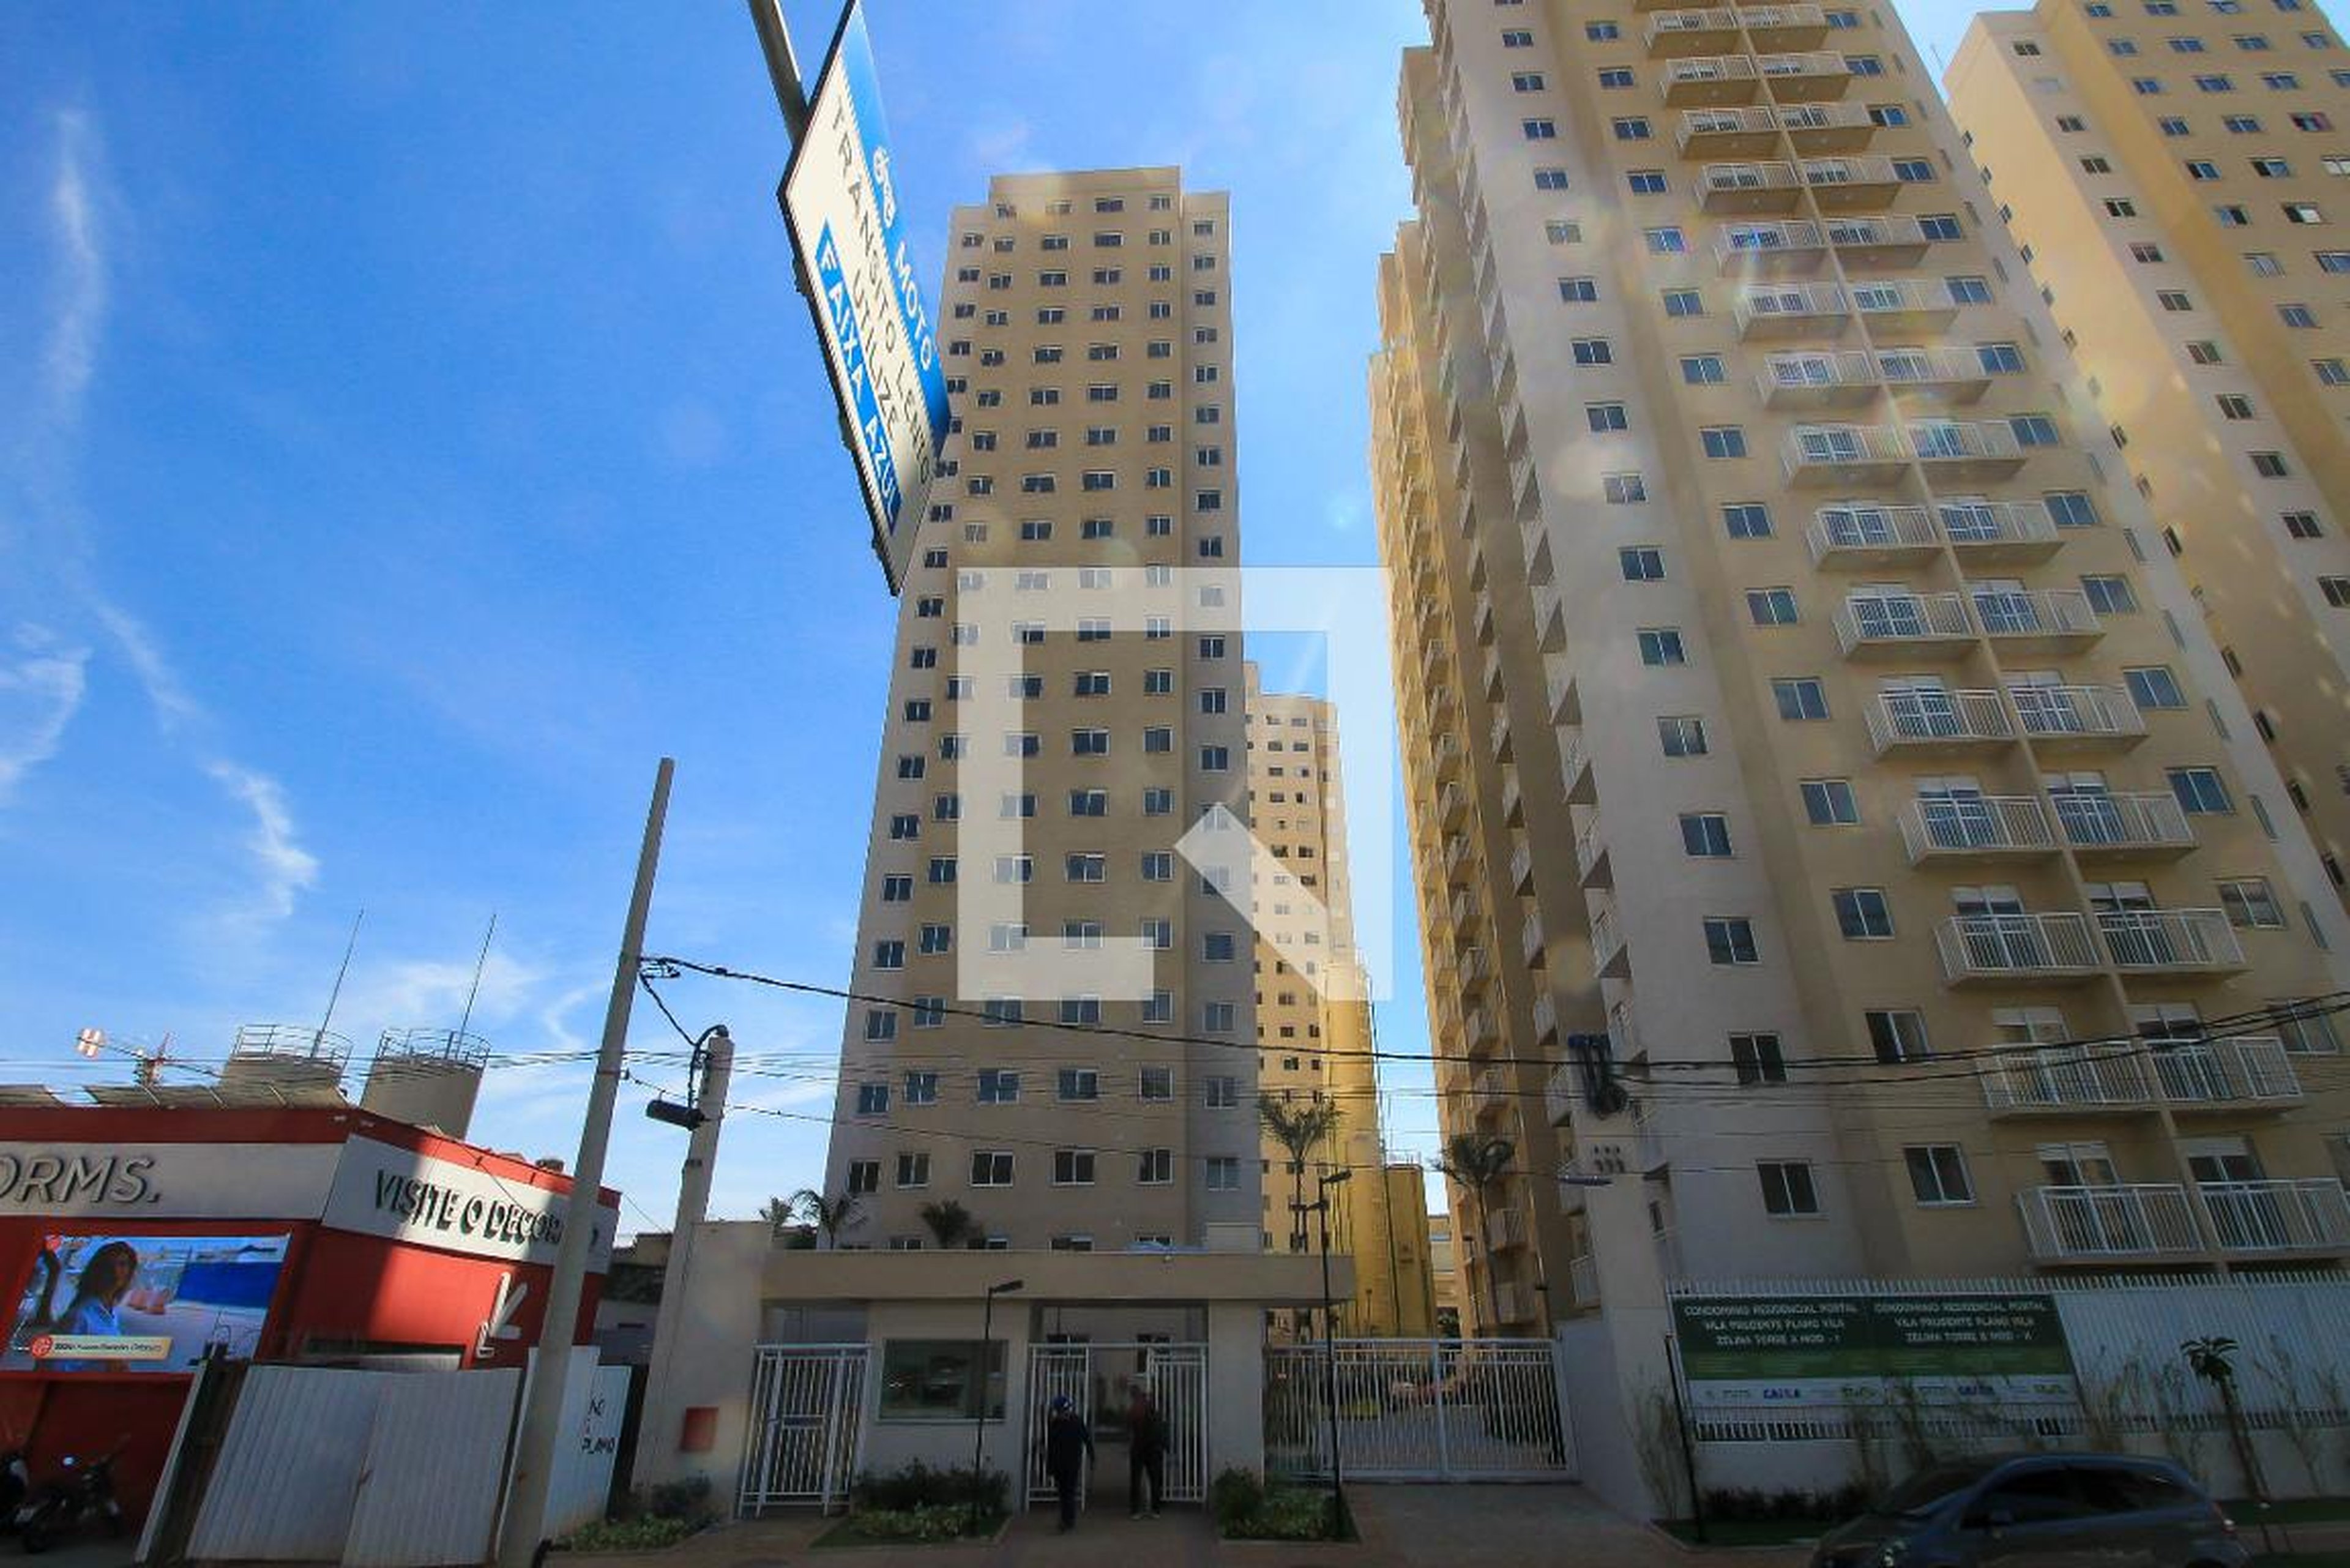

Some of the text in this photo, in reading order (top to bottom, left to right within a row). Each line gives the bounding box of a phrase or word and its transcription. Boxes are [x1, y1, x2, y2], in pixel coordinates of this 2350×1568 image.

[852, 269, 899, 439] UTILIZE
[895, 242, 932, 370] MOTO
[821, 240, 896, 525] FAIXA AZUL
[375, 1170, 599, 1247] VISITE O DECOR
